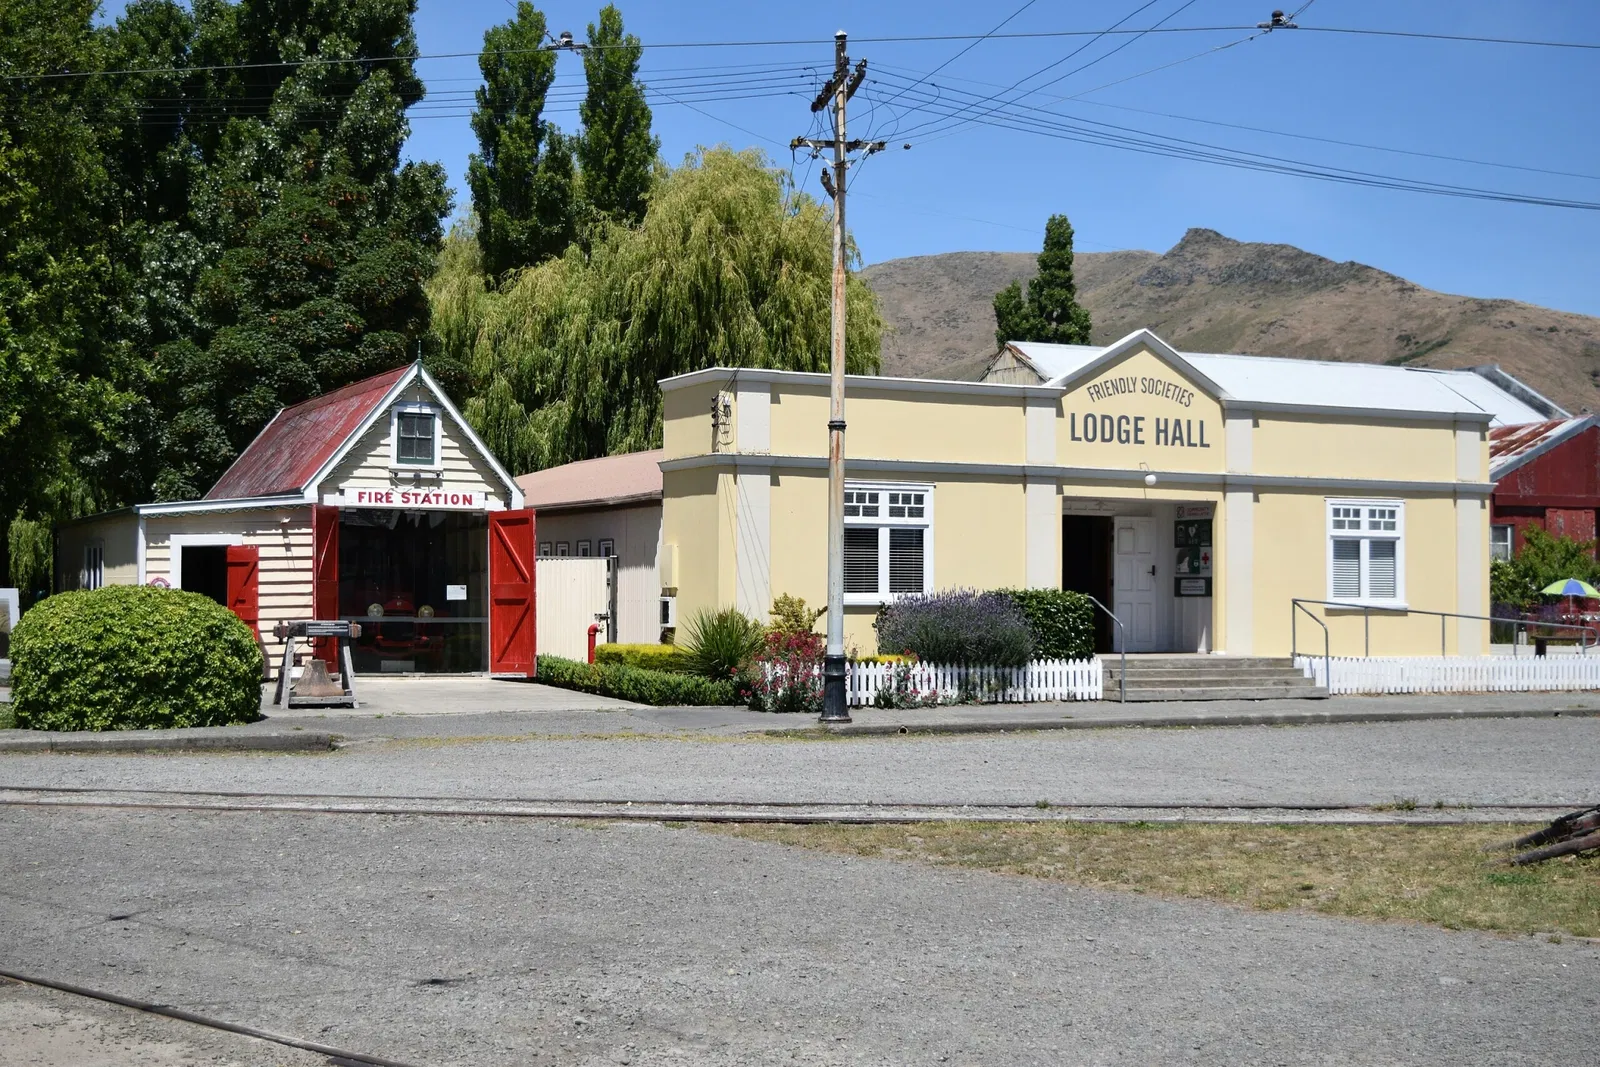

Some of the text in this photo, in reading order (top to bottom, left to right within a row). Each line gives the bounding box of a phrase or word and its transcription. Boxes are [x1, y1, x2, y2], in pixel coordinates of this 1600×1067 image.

[1086, 376, 1195, 408] FRIENDLY SOCIETIES
[1070, 412, 1211, 448] LODGE HALL
[357, 491, 473, 506] FIRE STATION
